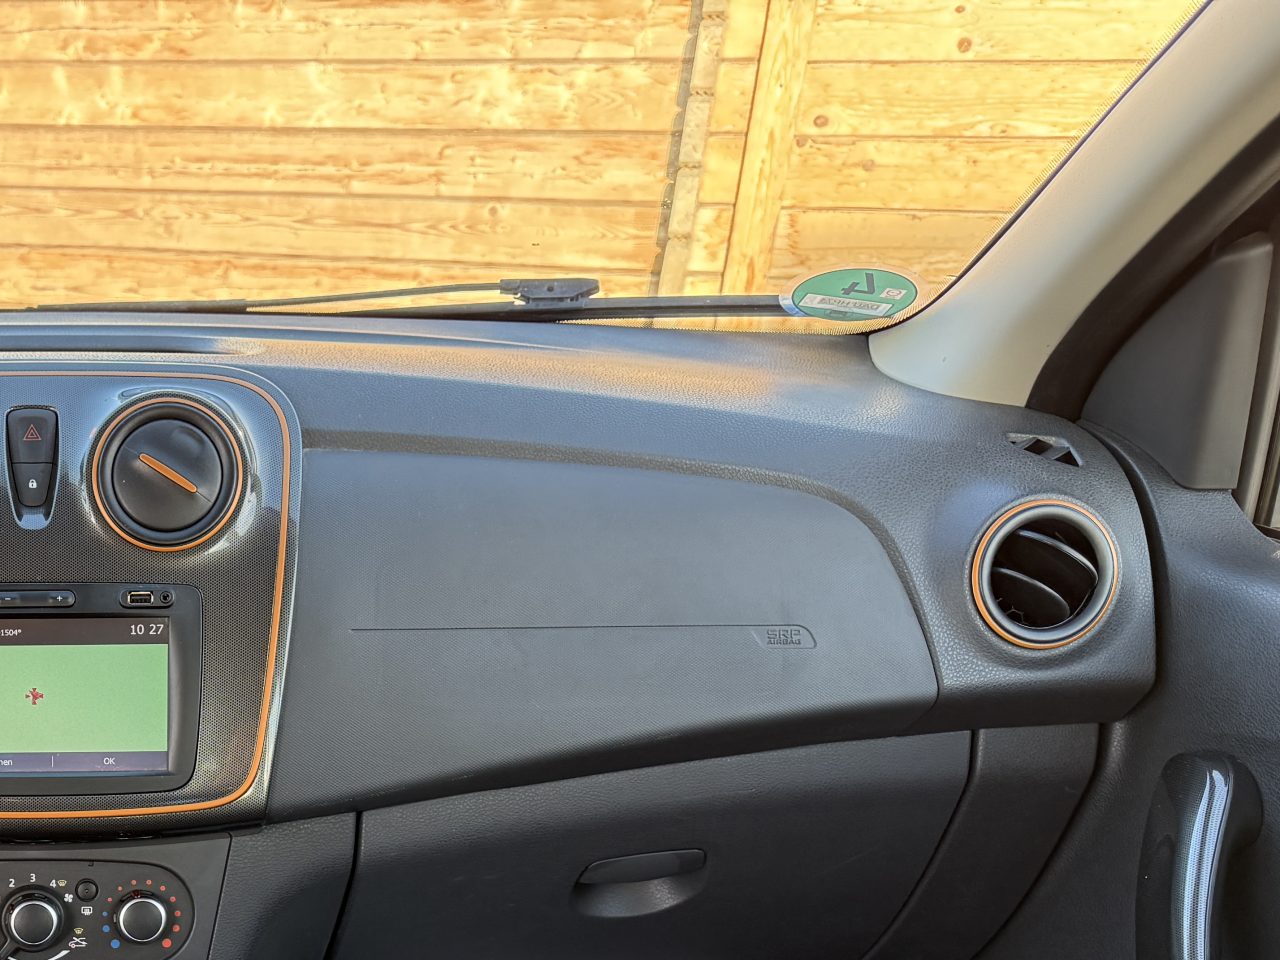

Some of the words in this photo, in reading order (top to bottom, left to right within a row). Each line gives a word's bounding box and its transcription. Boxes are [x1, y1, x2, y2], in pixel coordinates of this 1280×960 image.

[130, 624, 145, 635] 10
[149, 624, 164, 635] 27
[767, 629, 801, 639] SRP
[103, 757, 116, 766] OK
[29, 873, 36, 882] 3
[8, 878, 15, 888] 2
[49, 879, 57, 888] 4
